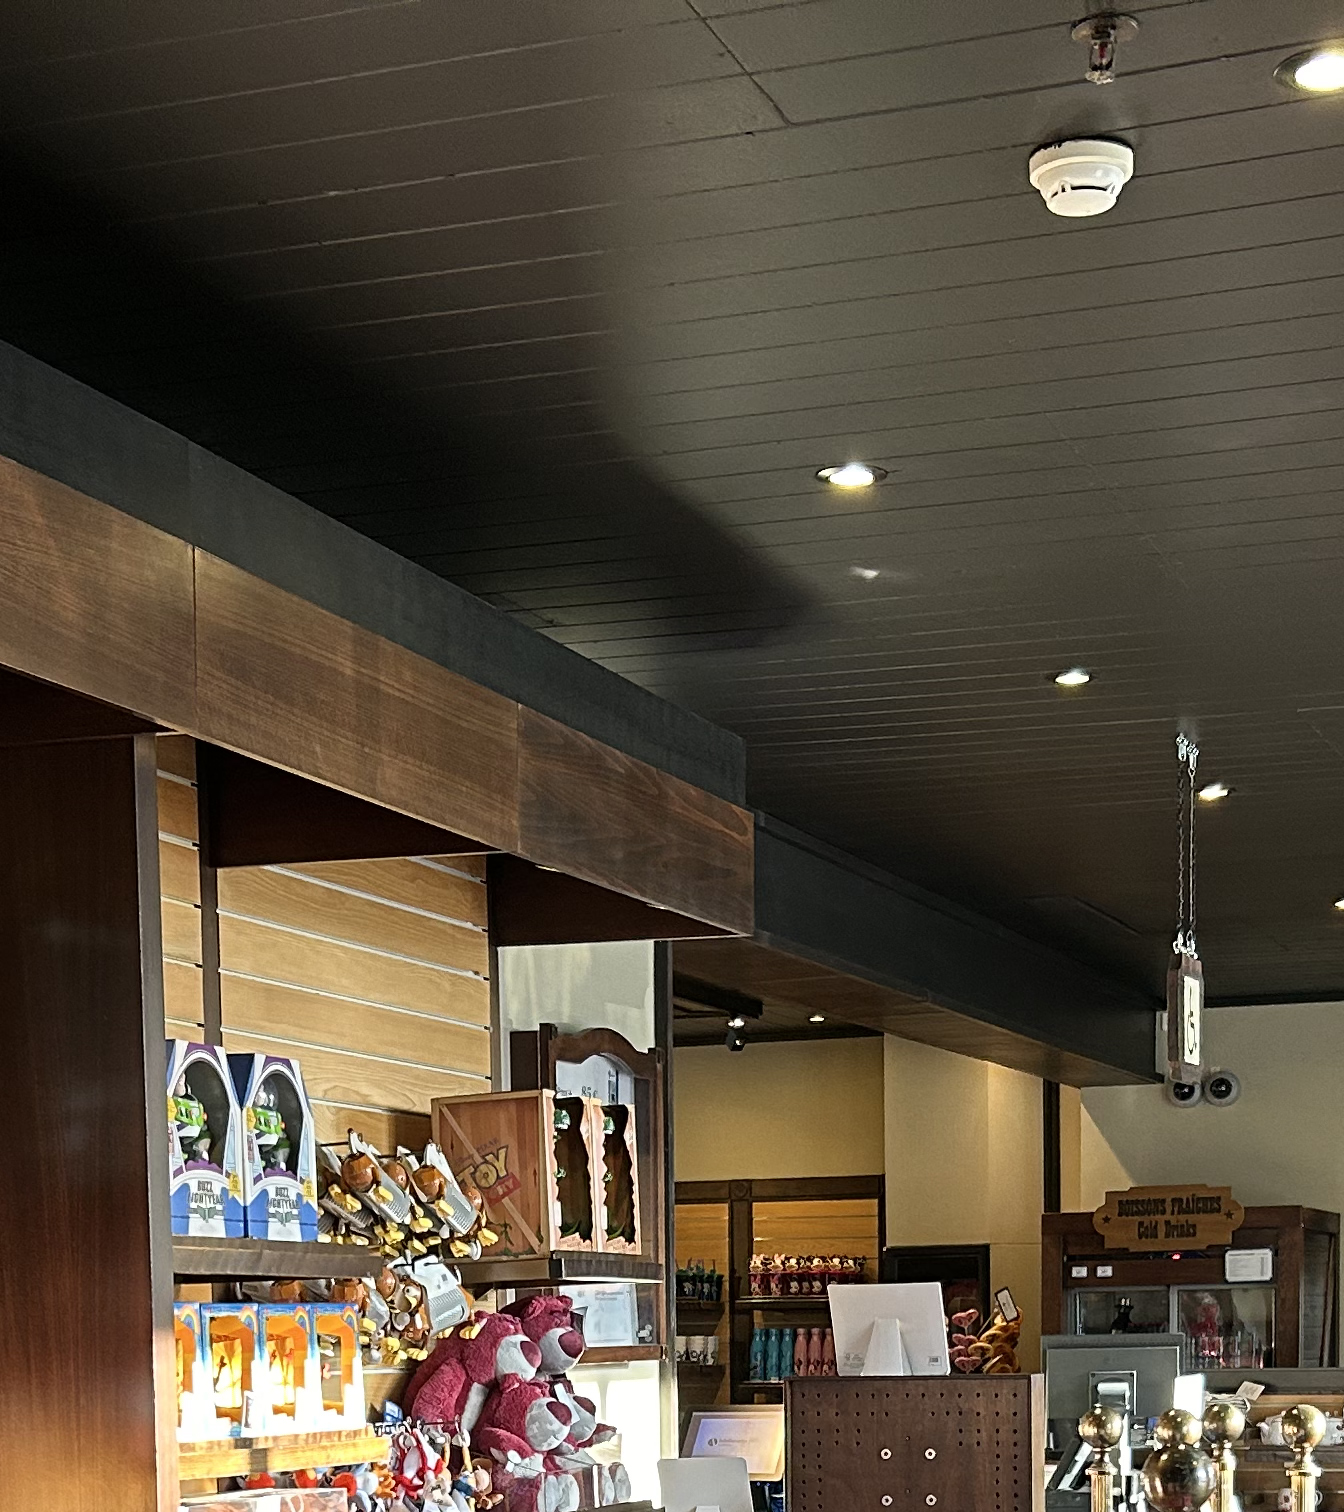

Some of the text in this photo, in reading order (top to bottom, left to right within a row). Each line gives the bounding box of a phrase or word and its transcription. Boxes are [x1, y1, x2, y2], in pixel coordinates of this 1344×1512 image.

[1118, 1197, 1166, 1217] BOISSONS
[1137, 1219, 1197, 1239] Cold Drinks
